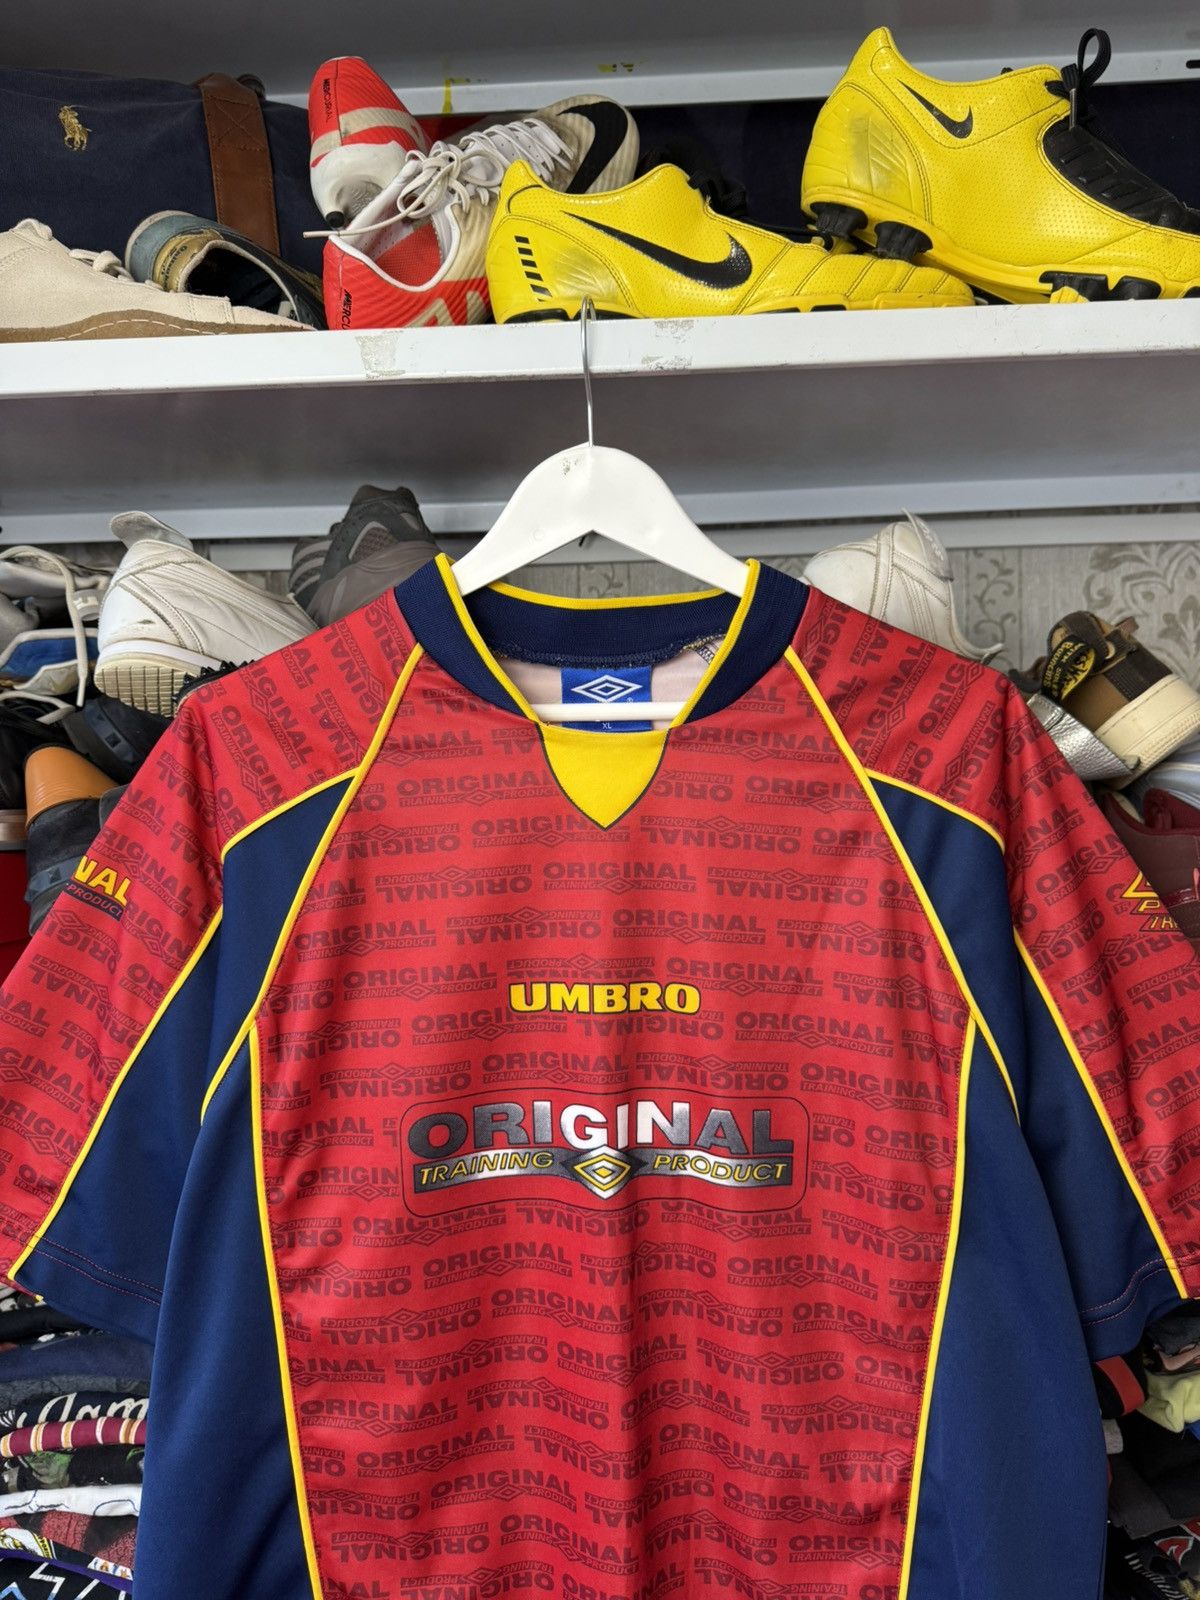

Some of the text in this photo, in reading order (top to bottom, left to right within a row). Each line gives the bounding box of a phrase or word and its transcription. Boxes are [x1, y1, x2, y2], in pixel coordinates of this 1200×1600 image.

[642, 826, 800, 854] ORIGINAL
[544, 862, 696, 880] ORIGINAL
[376, 876, 532, 903] ORIGINAL
[707, 879, 868, 906] ORIGINAL
[294, 919, 435, 950] ORIGINAL
[448, 920, 600, 945] ORIGINAL
[612, 908, 765, 932] ORIGINAL
[777, 931, 926, 963] ORIGINAL
[342, 962, 496, 989] ORIGINAL
[666, 956, 823, 984] ORIGINAL
[509, 981, 701, 1015] UMBRO
[735, 1011, 893, 1045] ORIGINAL
[482, 1051, 628, 1073] ORIGINAL
[636, 1064, 789, 1090] ORIGINAL
[320, 1072, 471, 1099] ORIGINAL
[407, 1100, 793, 1159] ORIGINAL
[420, 1151, 786, 1185] TRAINING PRODUCT
[423, 1242, 571, 1277] ORIGINAL
[727, 1254, 878, 1287] ORIGINAL
[491, 1288, 634, 1321] ORIGINAL
[638, 1300, 783, 1337] ORIGINAL
[321, 1309, 480, 1345] ORIGINAL
[395, 1346, 548, 1386] ORIGINAL
[697, 1350, 845, 1385] ORIGINAL
[300, 1397, 458, 1421] ORIGINAL
[467, 1390, 609, 1430] ORIGINAL
[761, 1412, 917, 1438] ORIGINAL
[357, 1425, 514, 1468] ORIGINAL
[660, 1424, 809, 1469] ORIGINAL
[431, 1469, 577, 1498] ORIGINAL
[723, 1482, 880, 1517] ORIGINAL
[331, 1535, 490, 1563] ORIGINAL
[500, 1514, 639, 1564] ORIGINAL
